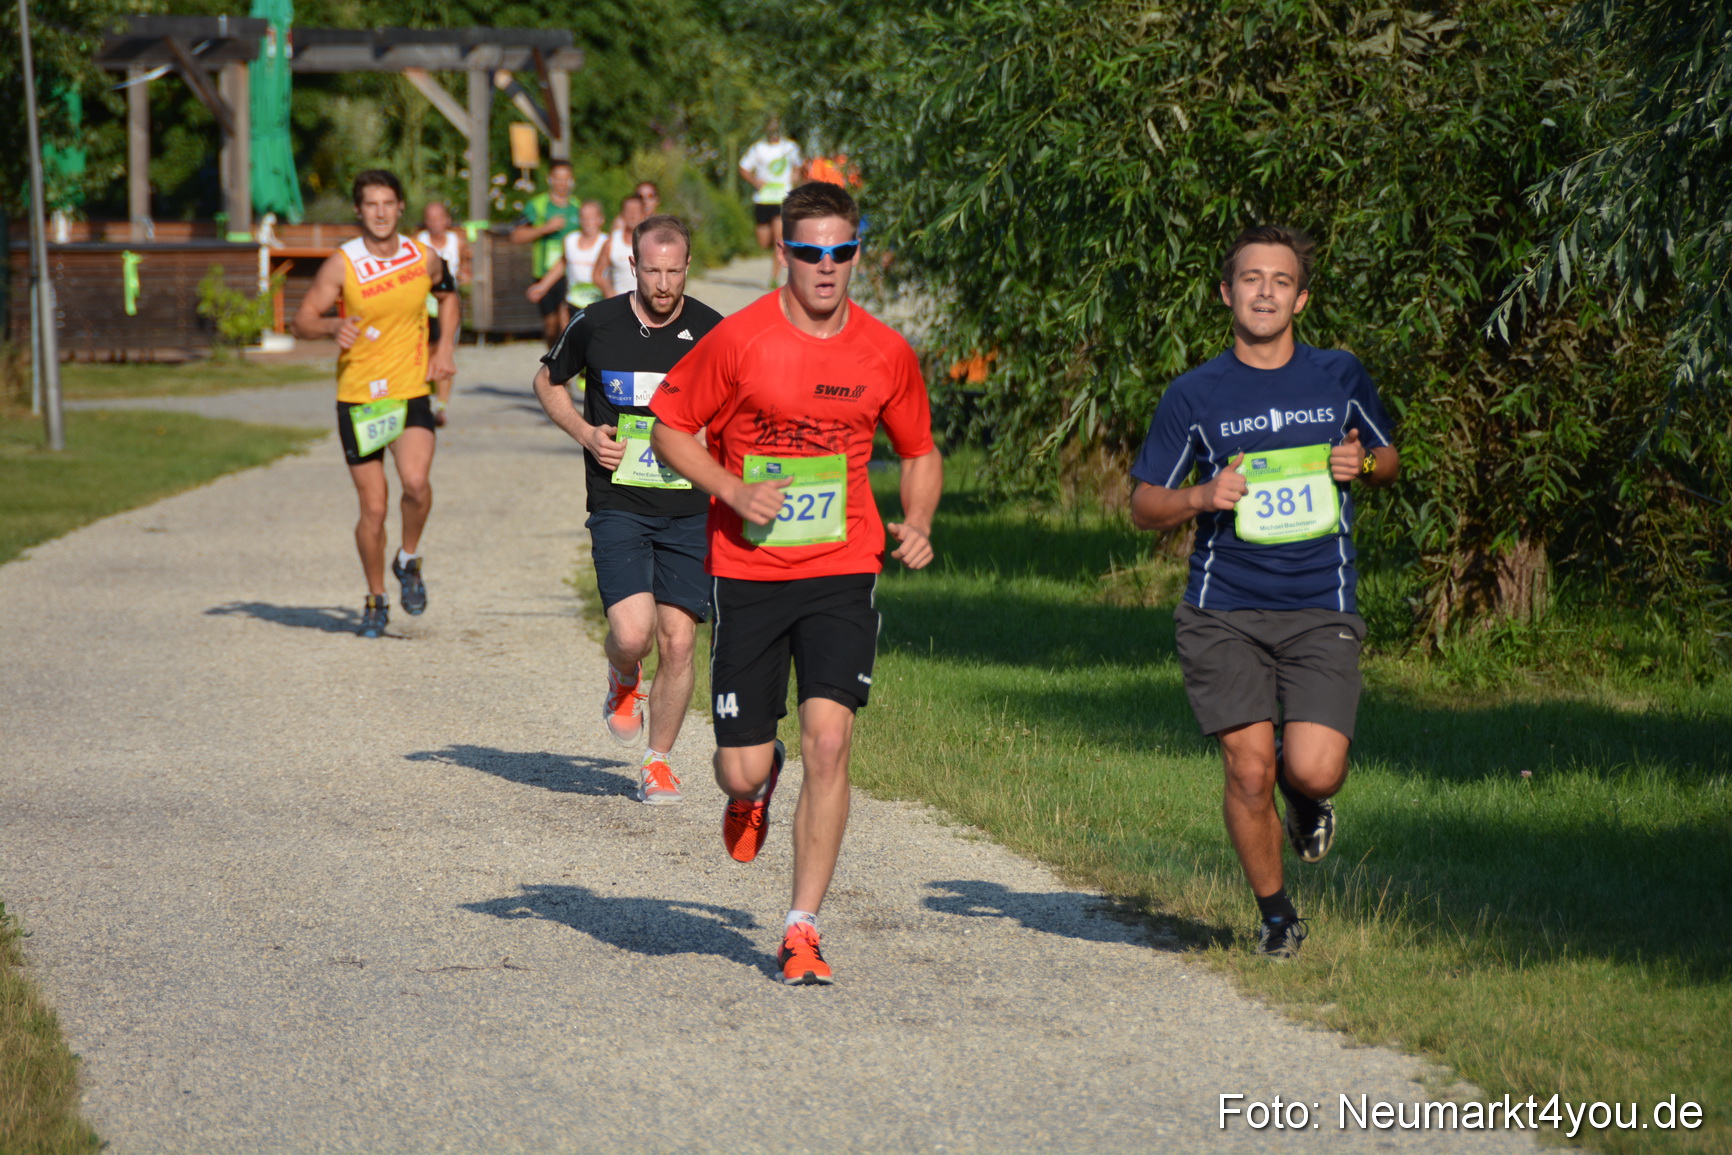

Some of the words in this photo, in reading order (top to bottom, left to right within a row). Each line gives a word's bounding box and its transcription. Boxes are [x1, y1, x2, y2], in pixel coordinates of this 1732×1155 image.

[361, 279, 396, 299] MAX
[366, 415, 399, 441] 878
[1220, 416, 1269, 437] EURO
[1285, 408, 1335, 426] POLES
[1254, 483, 1314, 520] 381
[716, 692, 740, 719] 44
